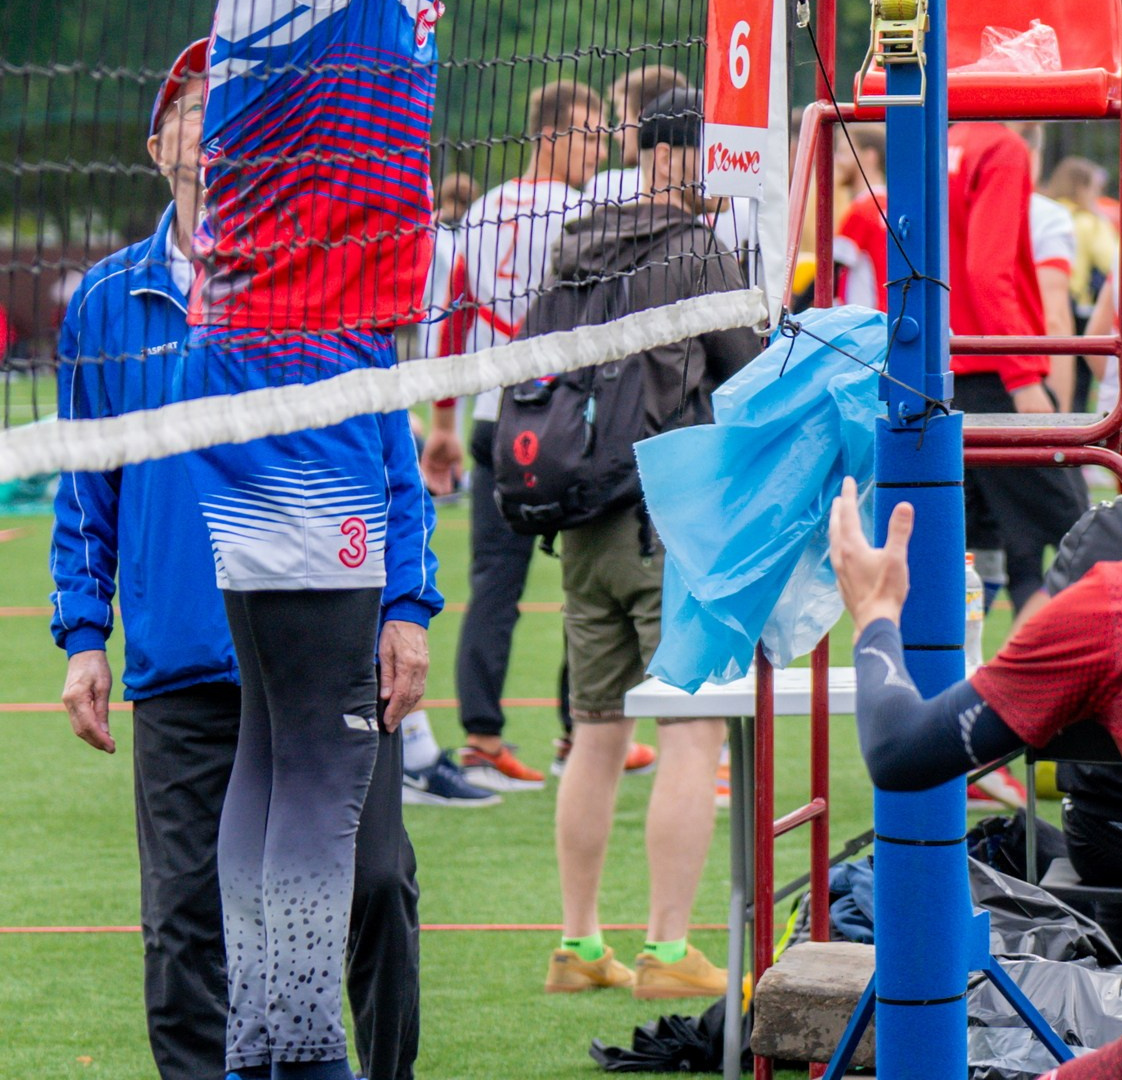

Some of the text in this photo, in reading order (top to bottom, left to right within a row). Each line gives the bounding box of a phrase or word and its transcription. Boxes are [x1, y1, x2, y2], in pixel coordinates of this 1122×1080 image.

[729, 20, 751, 89] 6
[707, 142, 761, 174] Комус
[338, 516, 368, 569] 3
